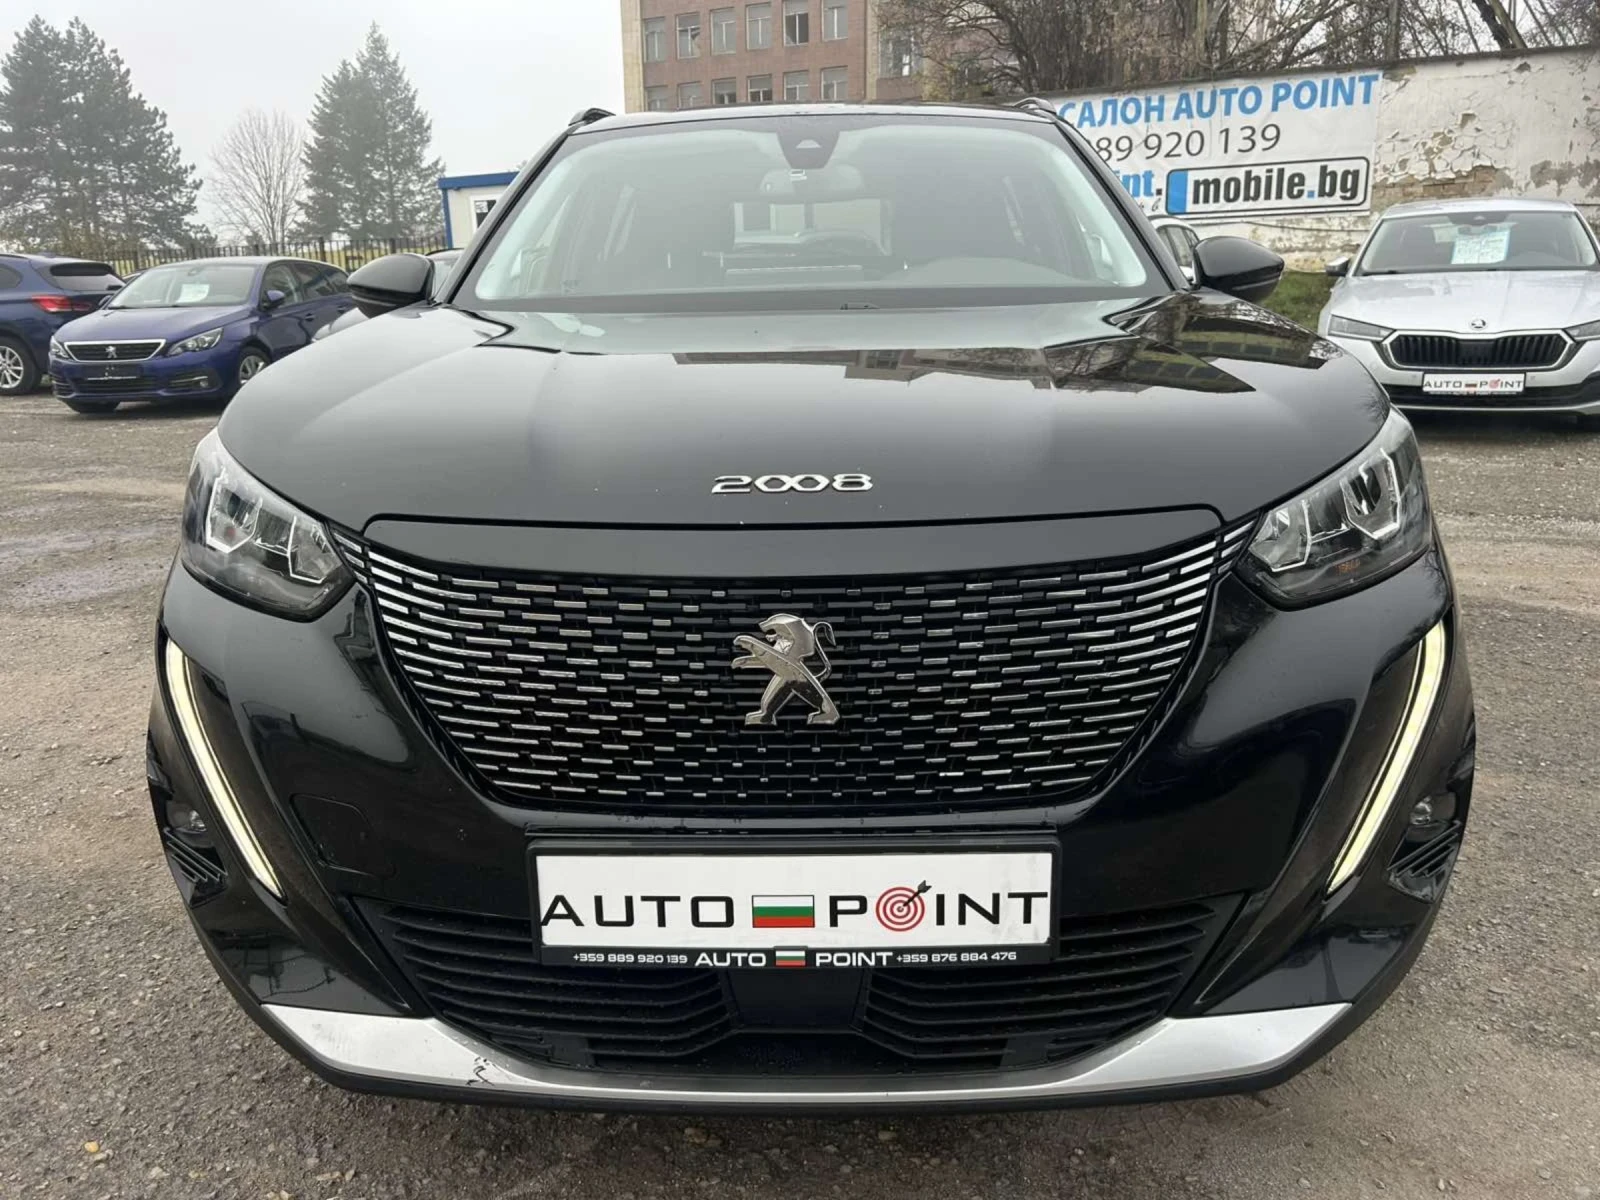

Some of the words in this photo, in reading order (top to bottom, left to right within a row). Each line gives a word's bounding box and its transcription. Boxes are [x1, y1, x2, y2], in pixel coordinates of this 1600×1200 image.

[1058, 95, 1165, 128] САЛОН
[1172, 86, 1263, 119] AUTO
[1271, 74, 1380, 113] POINT
[1144, 130, 1205, 160] 920
[1218, 123, 1281, 154] 139
[1113, 170, 1162, 197] nt.
[1192, 164, 1361, 205] mobile.bg
[1423, 380, 1463, 389] AUTO
[711, 473, 874, 494] 2008
[541, 894, 735, 928] AUTO
[573, 953, 605, 963] +359
[607, 953, 635, 964] 889
[637, 954, 665, 964] 920
[667, 954, 689, 965] 139
[695, 952, 767, 967] AUTO
[815, 951, 894, 967] POINT
[896, 953, 929, 963] +359
[931, 953, 958, 963] 876
[960, 952, 988, 962] 884
[991, 951, 1017, 961] 476
